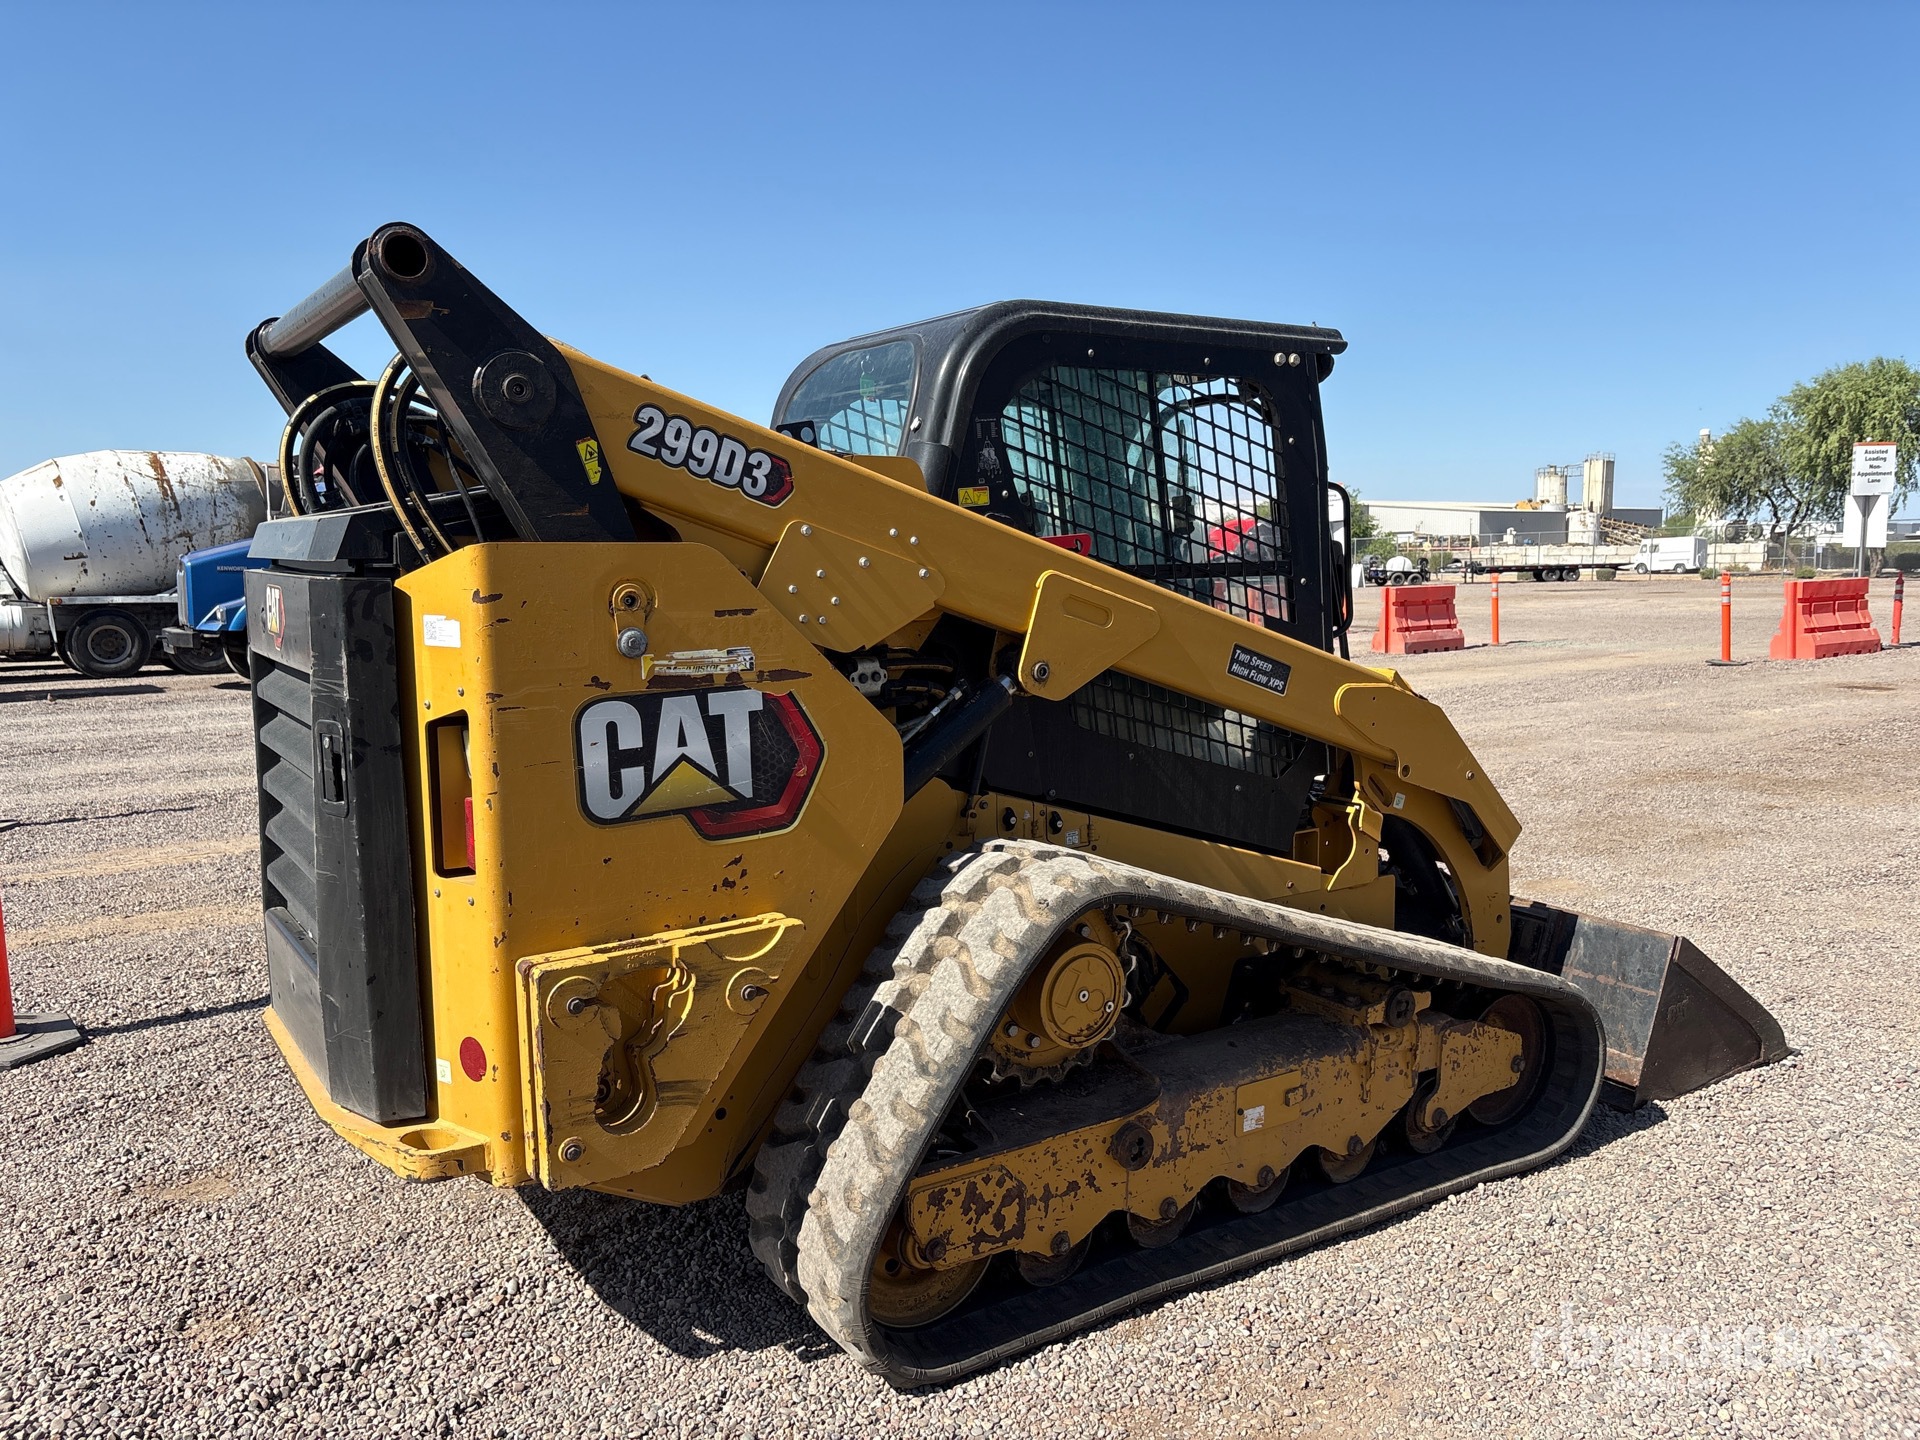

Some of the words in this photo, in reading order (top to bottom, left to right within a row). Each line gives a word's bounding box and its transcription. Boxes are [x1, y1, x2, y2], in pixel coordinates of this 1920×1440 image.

[629, 405, 772, 497] 299D3
[266, 586, 280, 634] CAT
[1268, 677, 1284, 690] XPS
[580, 689, 764, 820] CAT
